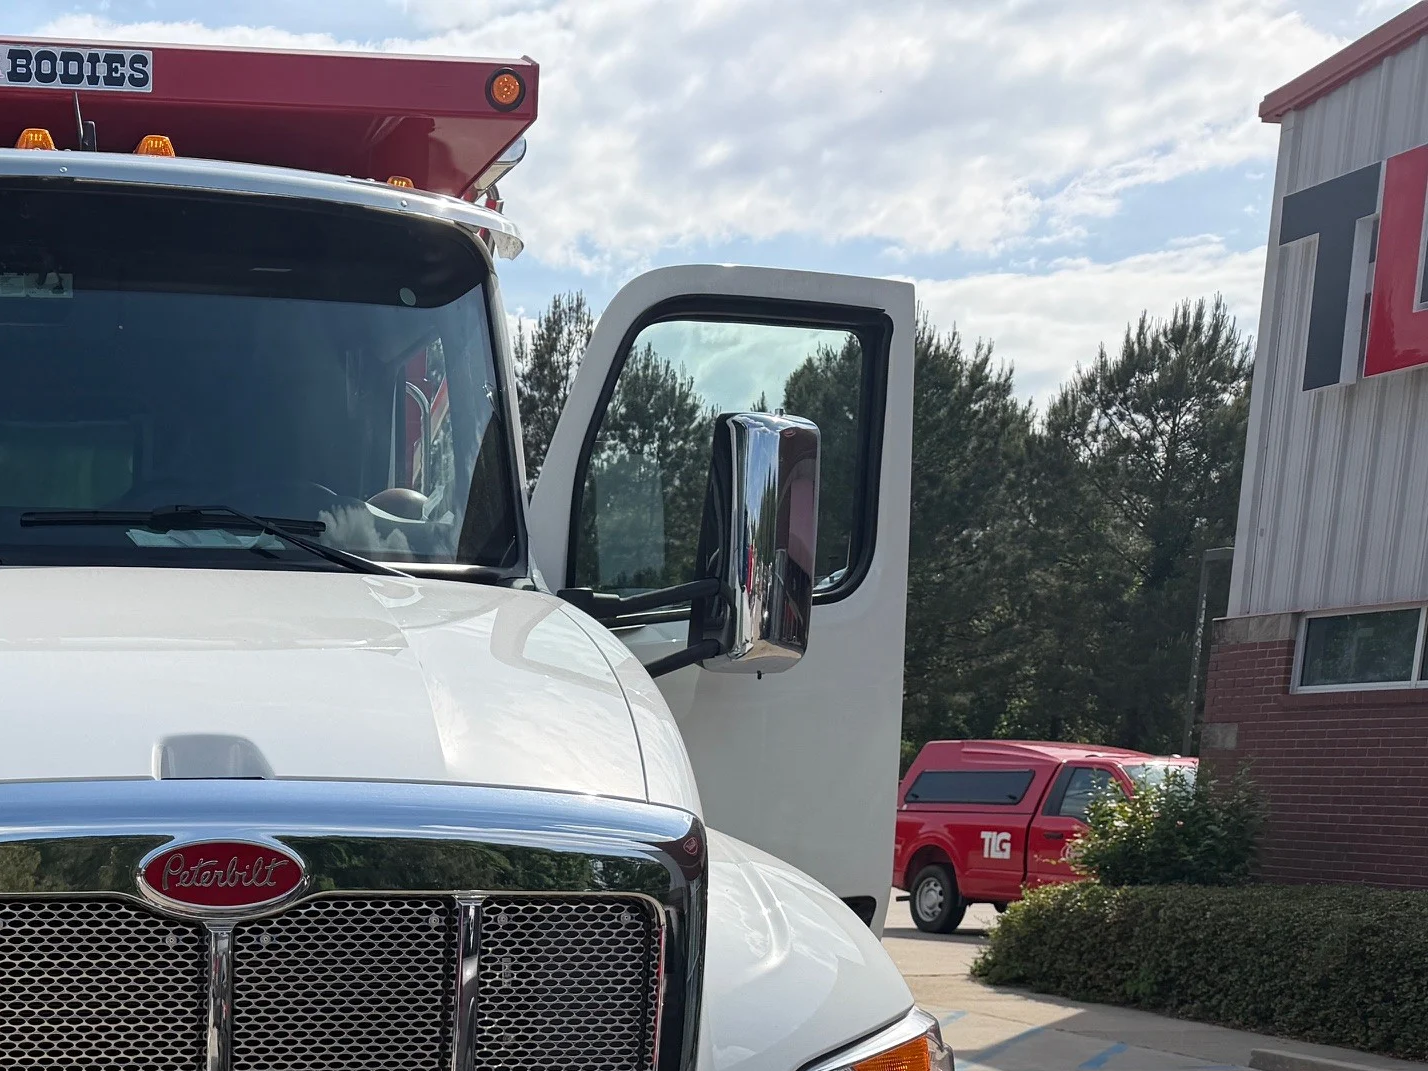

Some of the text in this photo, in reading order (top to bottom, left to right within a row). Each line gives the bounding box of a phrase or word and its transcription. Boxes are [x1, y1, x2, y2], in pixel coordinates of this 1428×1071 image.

[5, 48, 151, 88] BODIES
[1278, 143, 1428, 392] TL
[980, 830, 1012, 860] TLG
[161, 853, 290, 891] Peterbilt
